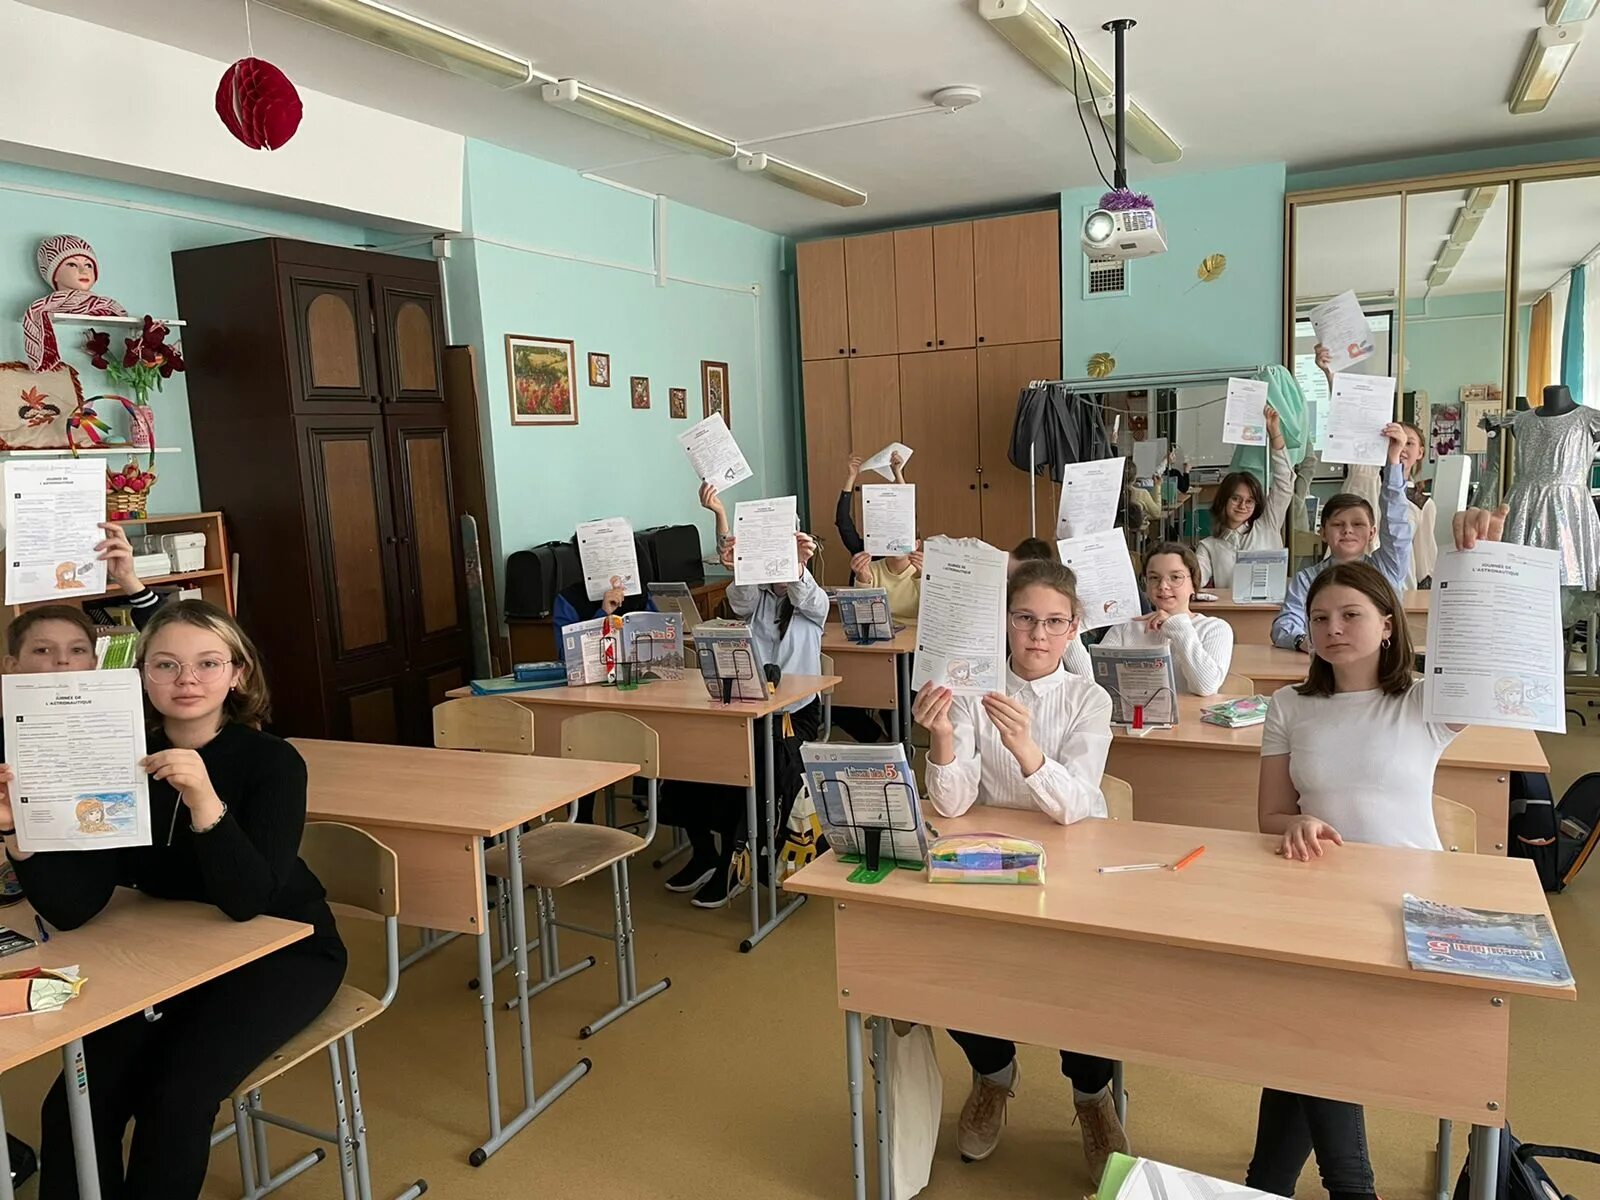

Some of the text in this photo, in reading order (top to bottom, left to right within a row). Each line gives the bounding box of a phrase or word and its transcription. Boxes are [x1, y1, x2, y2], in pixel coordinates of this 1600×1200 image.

[665, 626, 676, 639] 5
[884, 763, 898, 779] 5
[1427, 940, 1451, 954] 5
